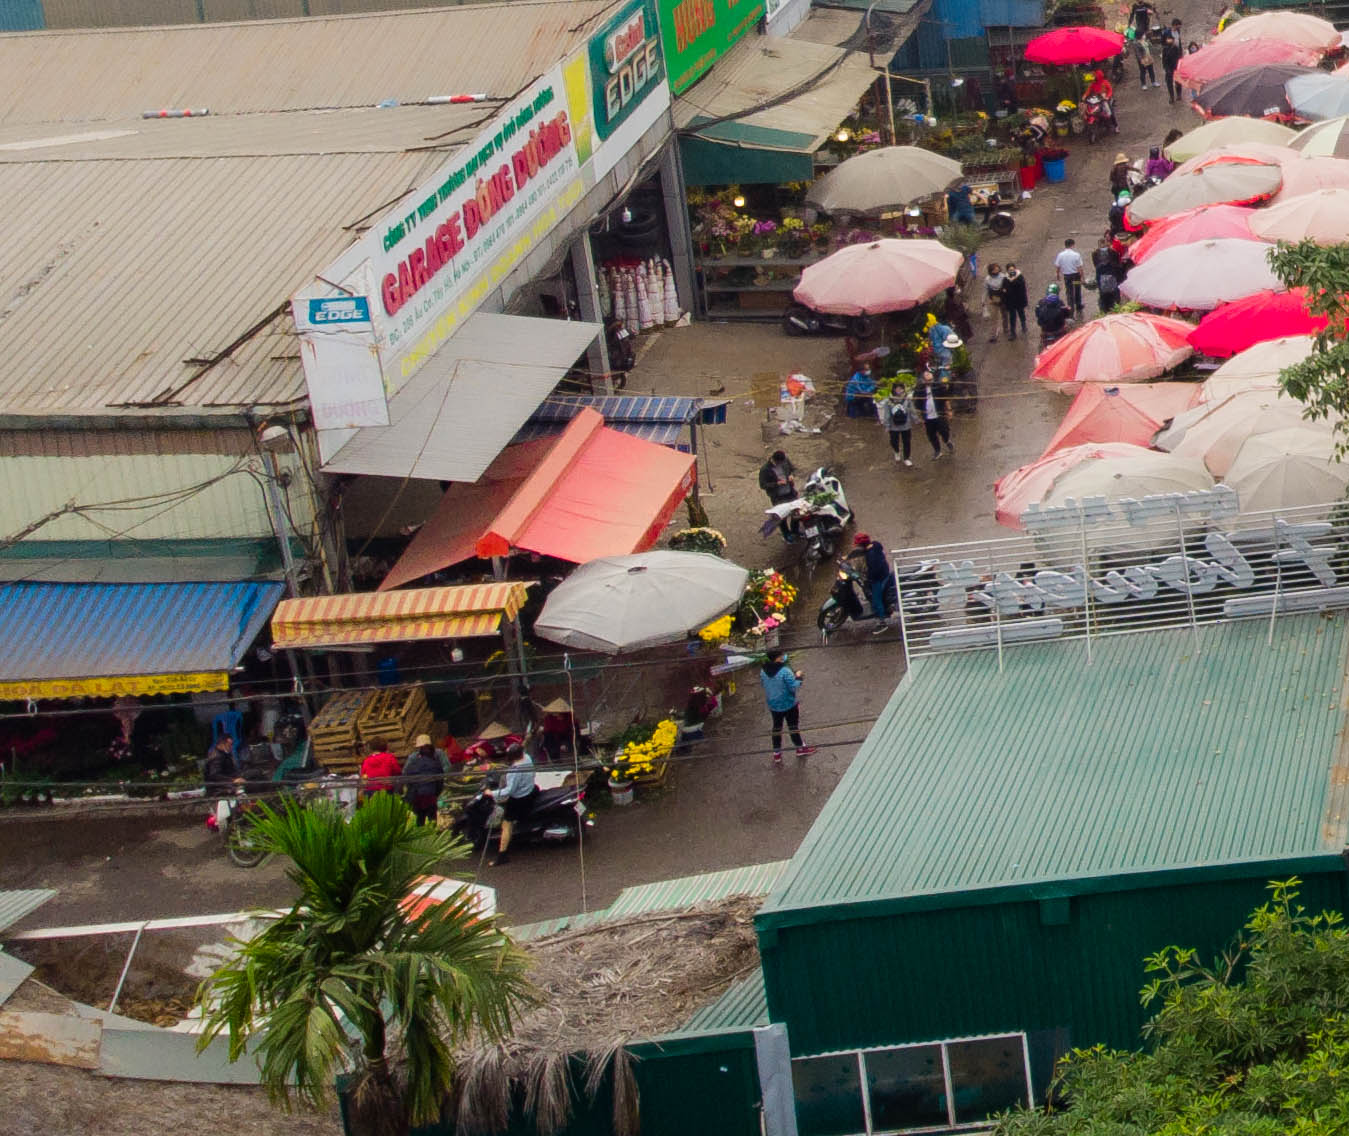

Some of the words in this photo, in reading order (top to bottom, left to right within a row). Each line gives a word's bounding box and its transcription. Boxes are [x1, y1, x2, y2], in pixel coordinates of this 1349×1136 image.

[606, 38, 659, 123] EDGE
[383, 218, 405, 253] CÔNG
[405, 211, 417, 232] TY
[382, 211, 465, 317] GARAGE
[315, 309, 364, 321] EDGE
